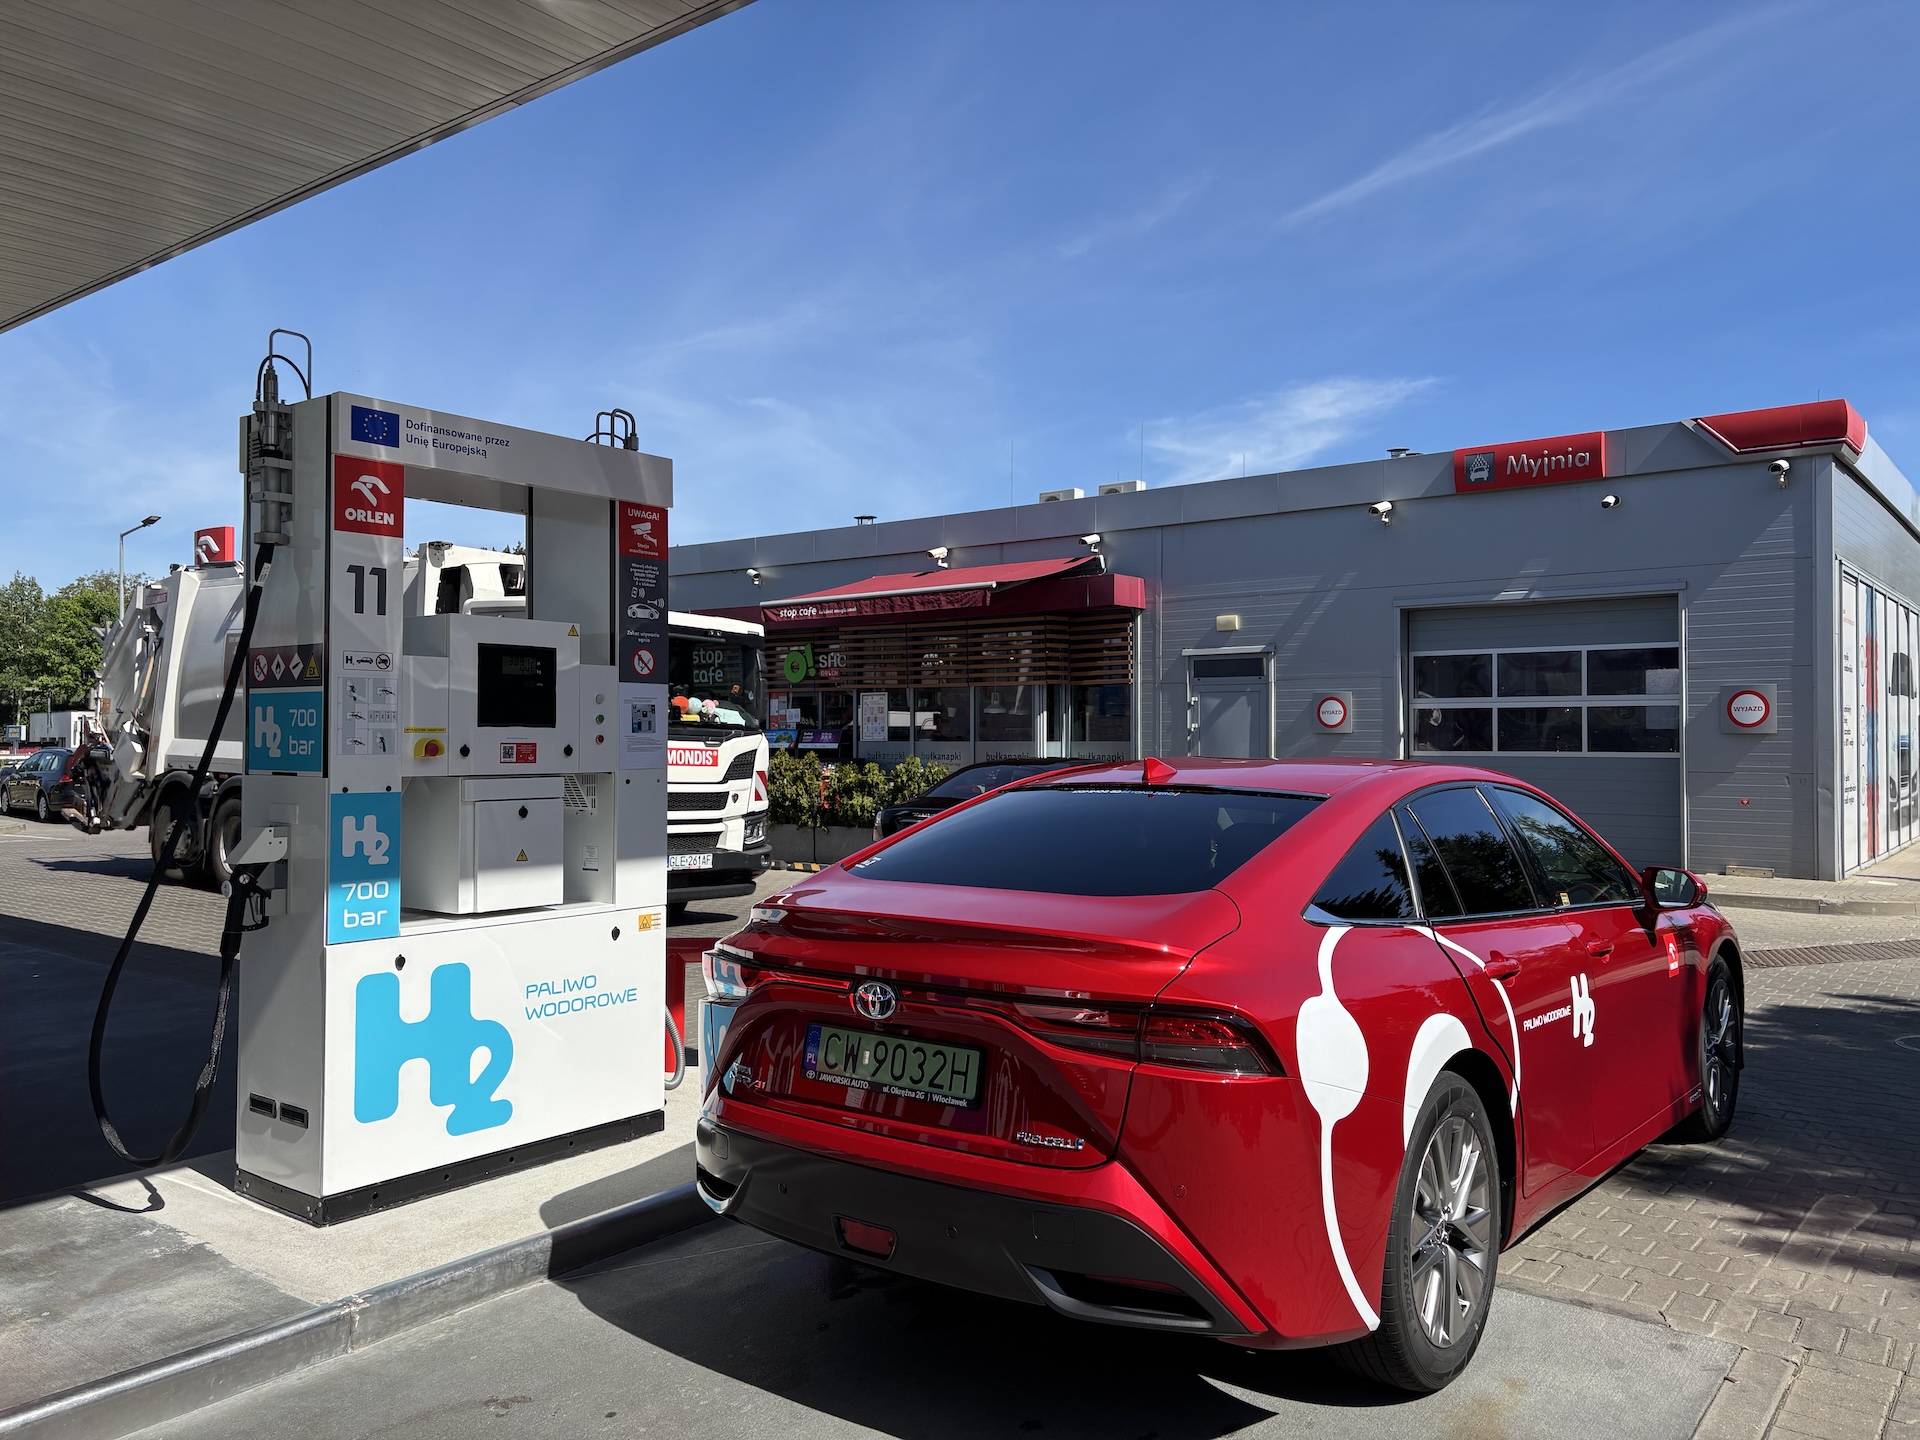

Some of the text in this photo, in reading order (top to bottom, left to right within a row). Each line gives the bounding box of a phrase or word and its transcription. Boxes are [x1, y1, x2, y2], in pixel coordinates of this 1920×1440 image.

[406, 419, 510, 447] Dofinansowane przez
[406, 433, 487, 458] Unię Europejską
[1507, 447, 1590, 478] Myjnia
[345, 507, 395, 525] ORLEN
[627, 508, 660, 521] UWAGA!
[346, 564, 387, 616] 11
[780, 608, 797, 619] stop
[799, 606, 817, 617] cafe
[693, 647, 723, 668] stop
[693, 666, 723, 685] cafe
[288, 708, 317, 727] 700
[254, 706, 281, 758] H2
[288, 735, 315, 755] bar
[921, 752, 961, 762] bułkanapki
[342, 815, 390, 865] H2
[669, 855, 686, 867] GLE
[341, 881, 390, 901] 700
[343, 909, 388, 928] bar
[526, 975, 597, 999] PALIWO
[525, 988, 638, 1021] WODOROWE
[1523, 1005, 1572, 1032] PALIWO WODOROWE
[354, 962, 514, 1137] H2
[806, 1052, 816, 1064] PL
[824, 1032, 971, 1095] CW 9032H
[819, 1074, 850, 1087] JAWORSKI
[890, 1087, 916, 1098] Okrężna
[916, 1090, 925, 1100] 2G
[932, 1093, 968, 1108] Włocławek
[1403, 1237, 1415, 1322] DUNLOP
